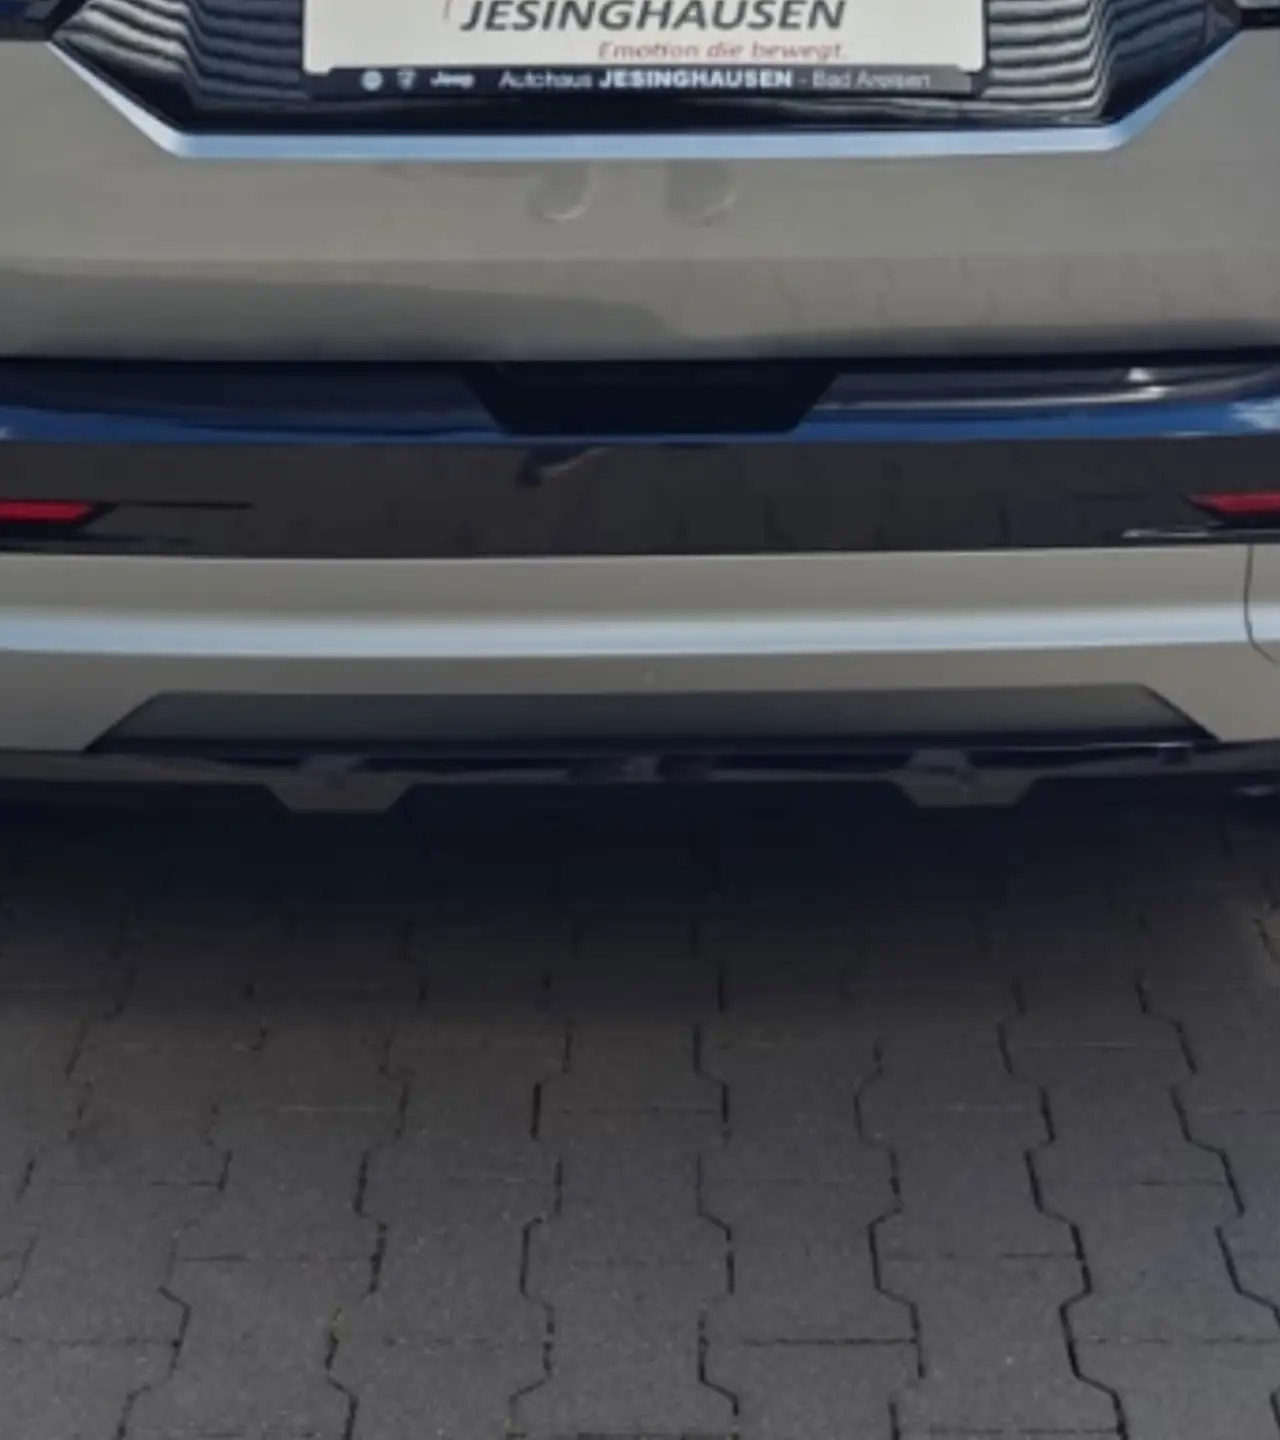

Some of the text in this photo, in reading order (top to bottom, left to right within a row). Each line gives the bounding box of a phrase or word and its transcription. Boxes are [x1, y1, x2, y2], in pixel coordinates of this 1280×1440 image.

[460, 0, 846, 32] JESINGHAUSEN
[598, 40, 699, 60] Emotion
[706, 40, 744, 60] die
[498, 70, 592, 90] Autohaus
[598, 69, 793, 90] JESINGHAUSEN
